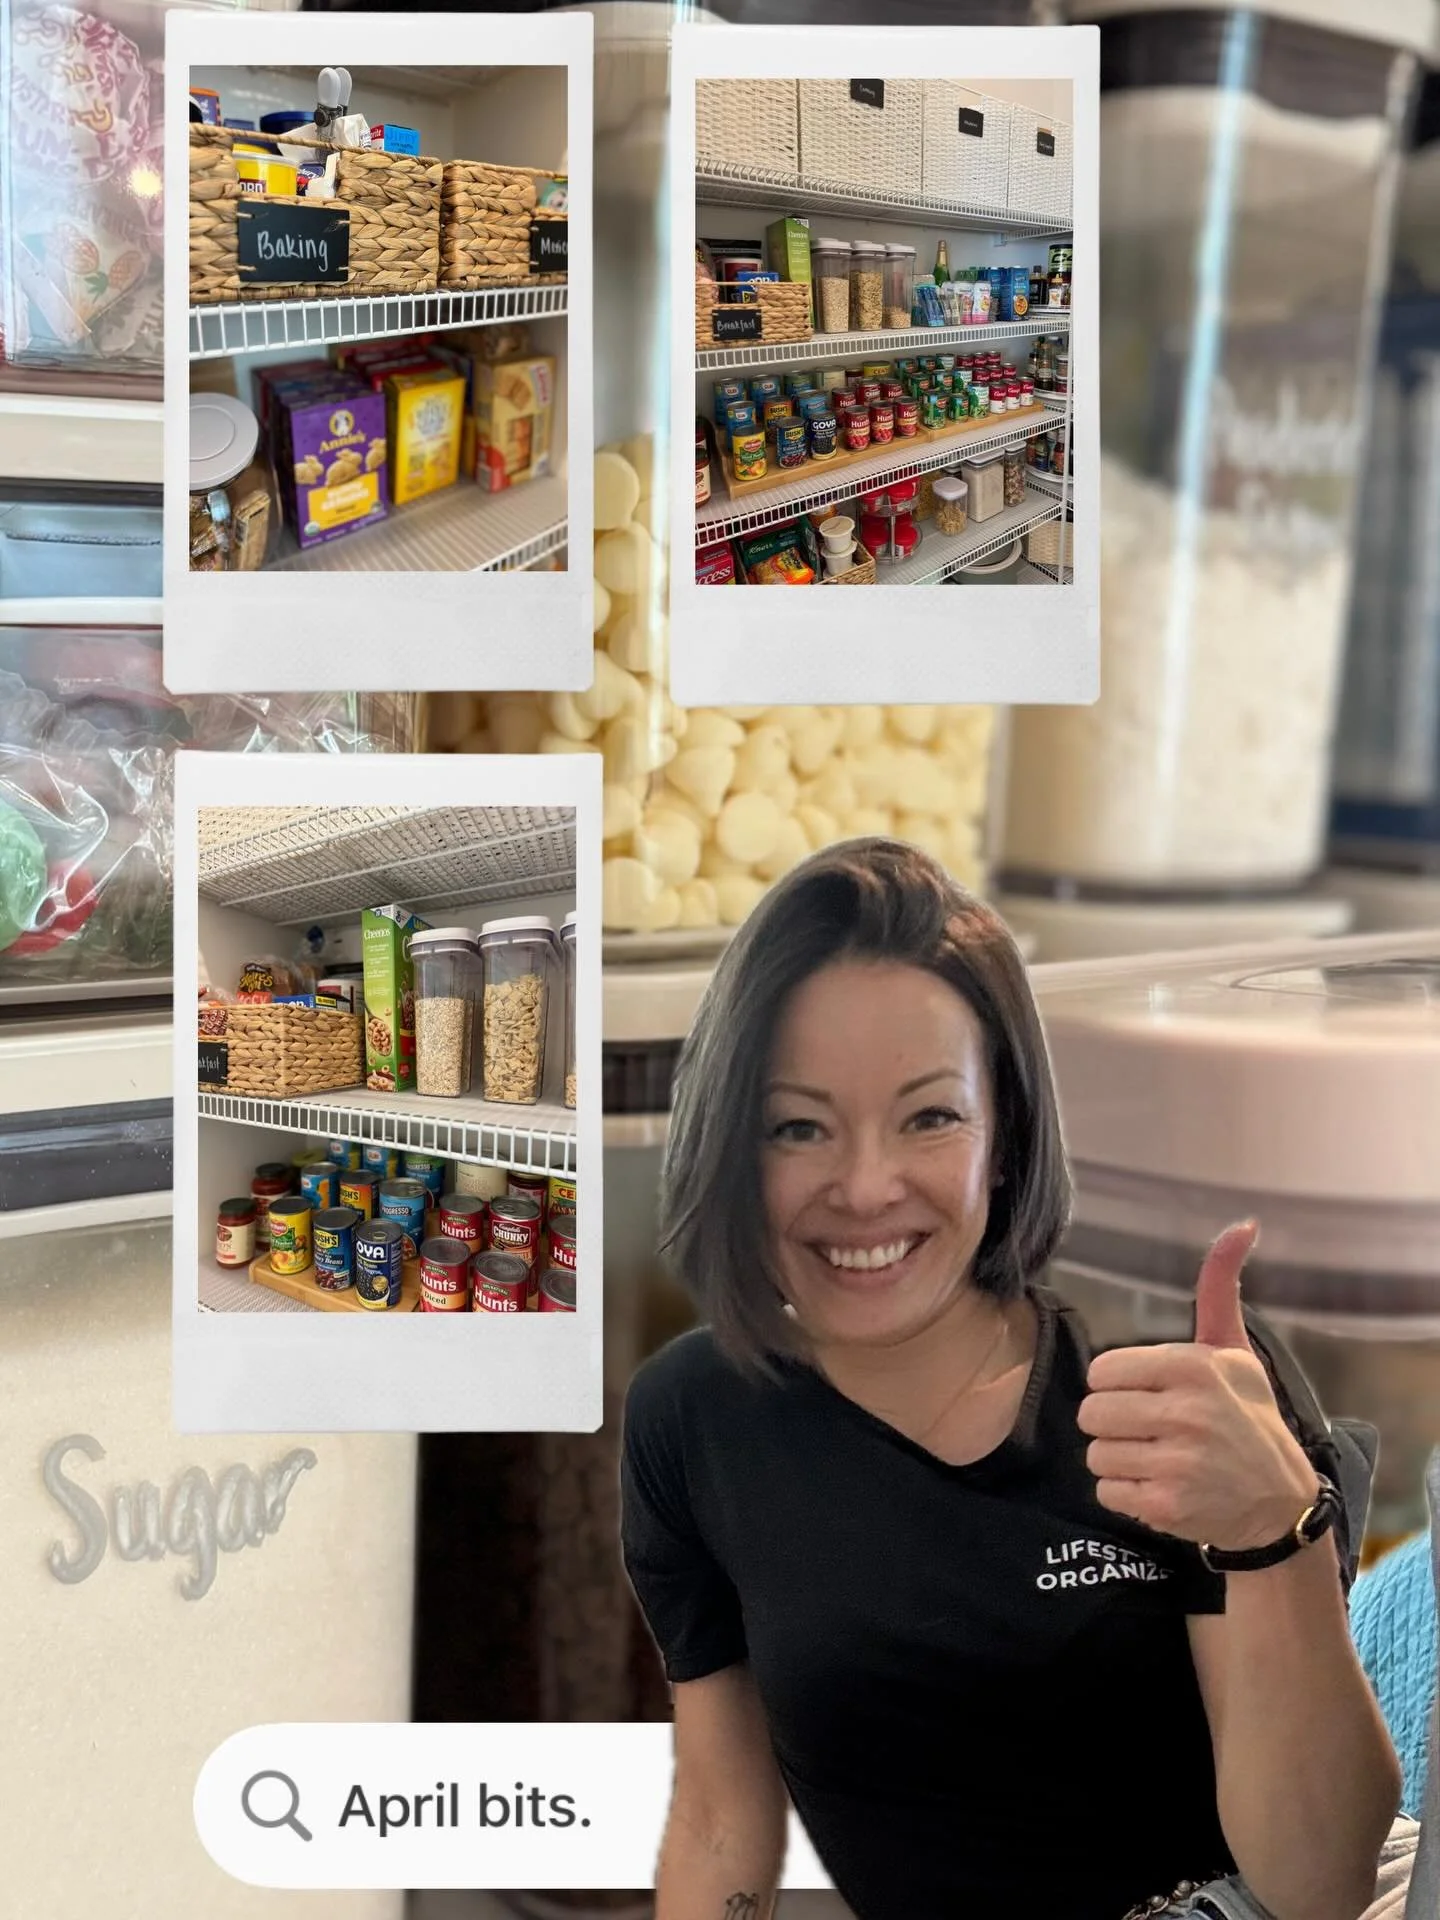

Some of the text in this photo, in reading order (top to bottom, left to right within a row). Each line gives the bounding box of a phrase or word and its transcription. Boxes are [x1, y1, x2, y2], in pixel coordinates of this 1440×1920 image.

[257, 230, 329, 272] Baking
[717, 319, 756, 333] Breakfast
[812, 418, 837, 430] GOYA
[363, 927, 391, 940] Cheerios
[493, 1225, 529, 1244] CHUNKY
[423, 1290, 447, 1305] Diced
[41, 1433, 318, 1602] Sugar
